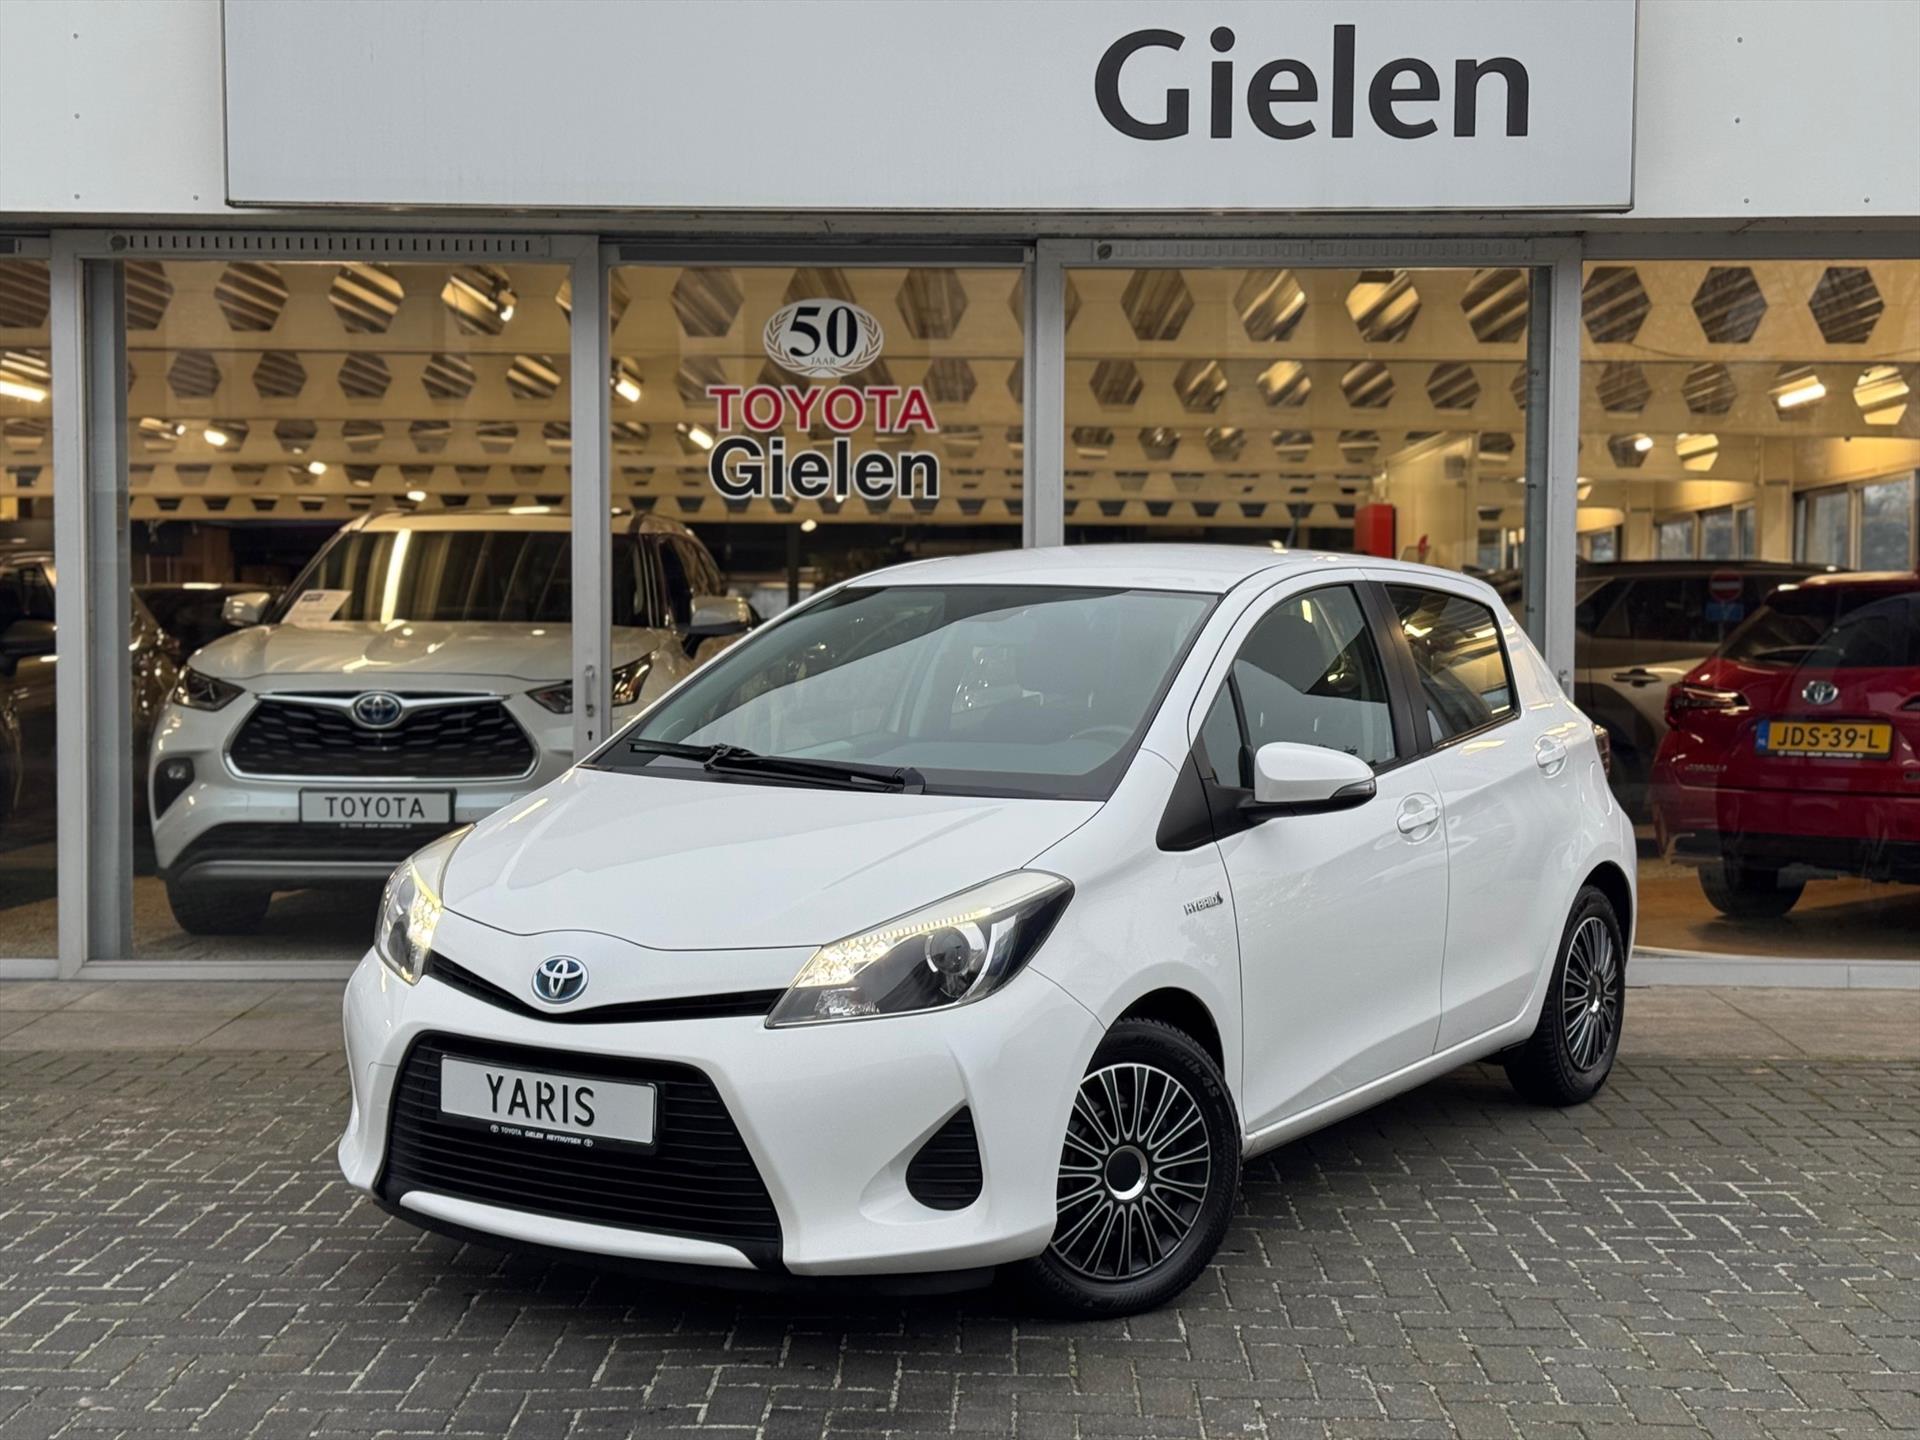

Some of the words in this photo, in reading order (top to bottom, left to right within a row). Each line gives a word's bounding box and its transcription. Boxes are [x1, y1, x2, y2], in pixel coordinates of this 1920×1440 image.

[1094, 24, 1529, 141] Gielen
[789, 306, 858, 358] 50
[810, 356, 837, 366] JAAR
[707, 386, 937, 432] TOYOTA
[710, 436, 939, 499] Gielen
[1776, 726, 1880, 749] JDS-39-L
[324, 796, 425, 819] TOYOTA
[486, 1073, 595, 1127] YARIS
[501, 1126, 522, 1136] TOYOTA
